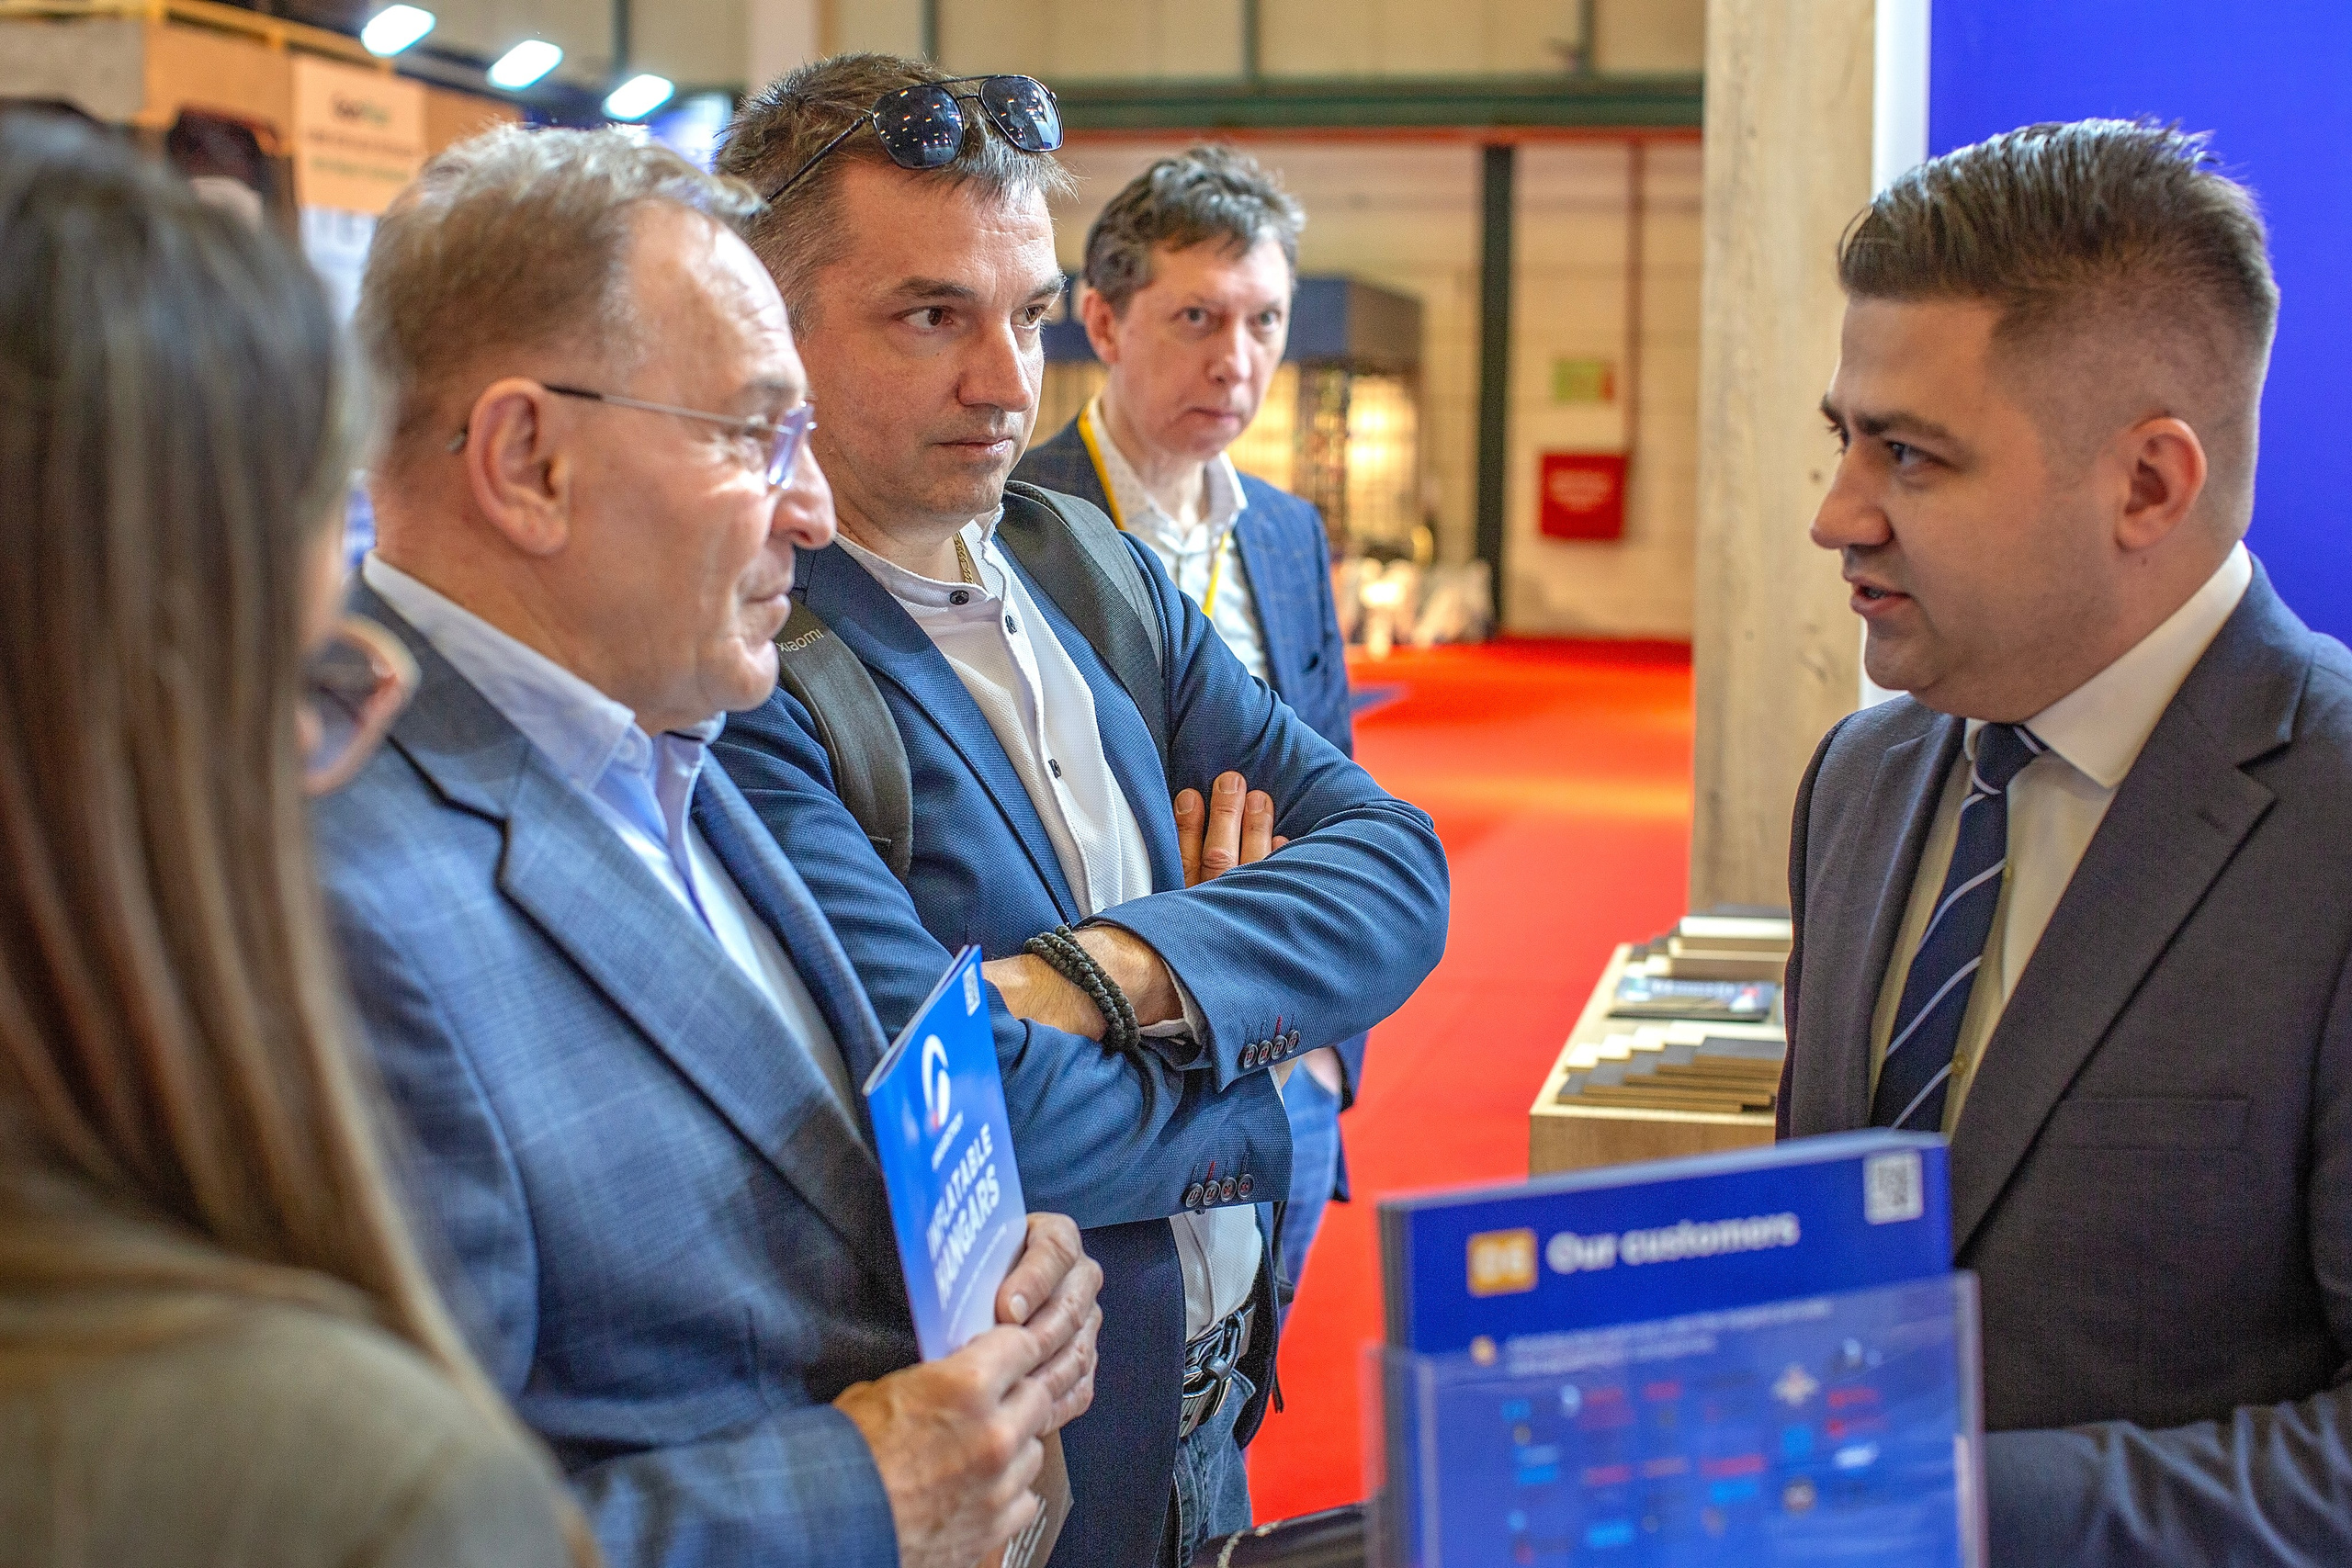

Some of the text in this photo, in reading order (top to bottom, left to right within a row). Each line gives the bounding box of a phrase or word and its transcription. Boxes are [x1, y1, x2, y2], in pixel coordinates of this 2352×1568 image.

[775, 628, 824, 652] xiaomi
[1546, 1212, 1801, 1275] Our customers
